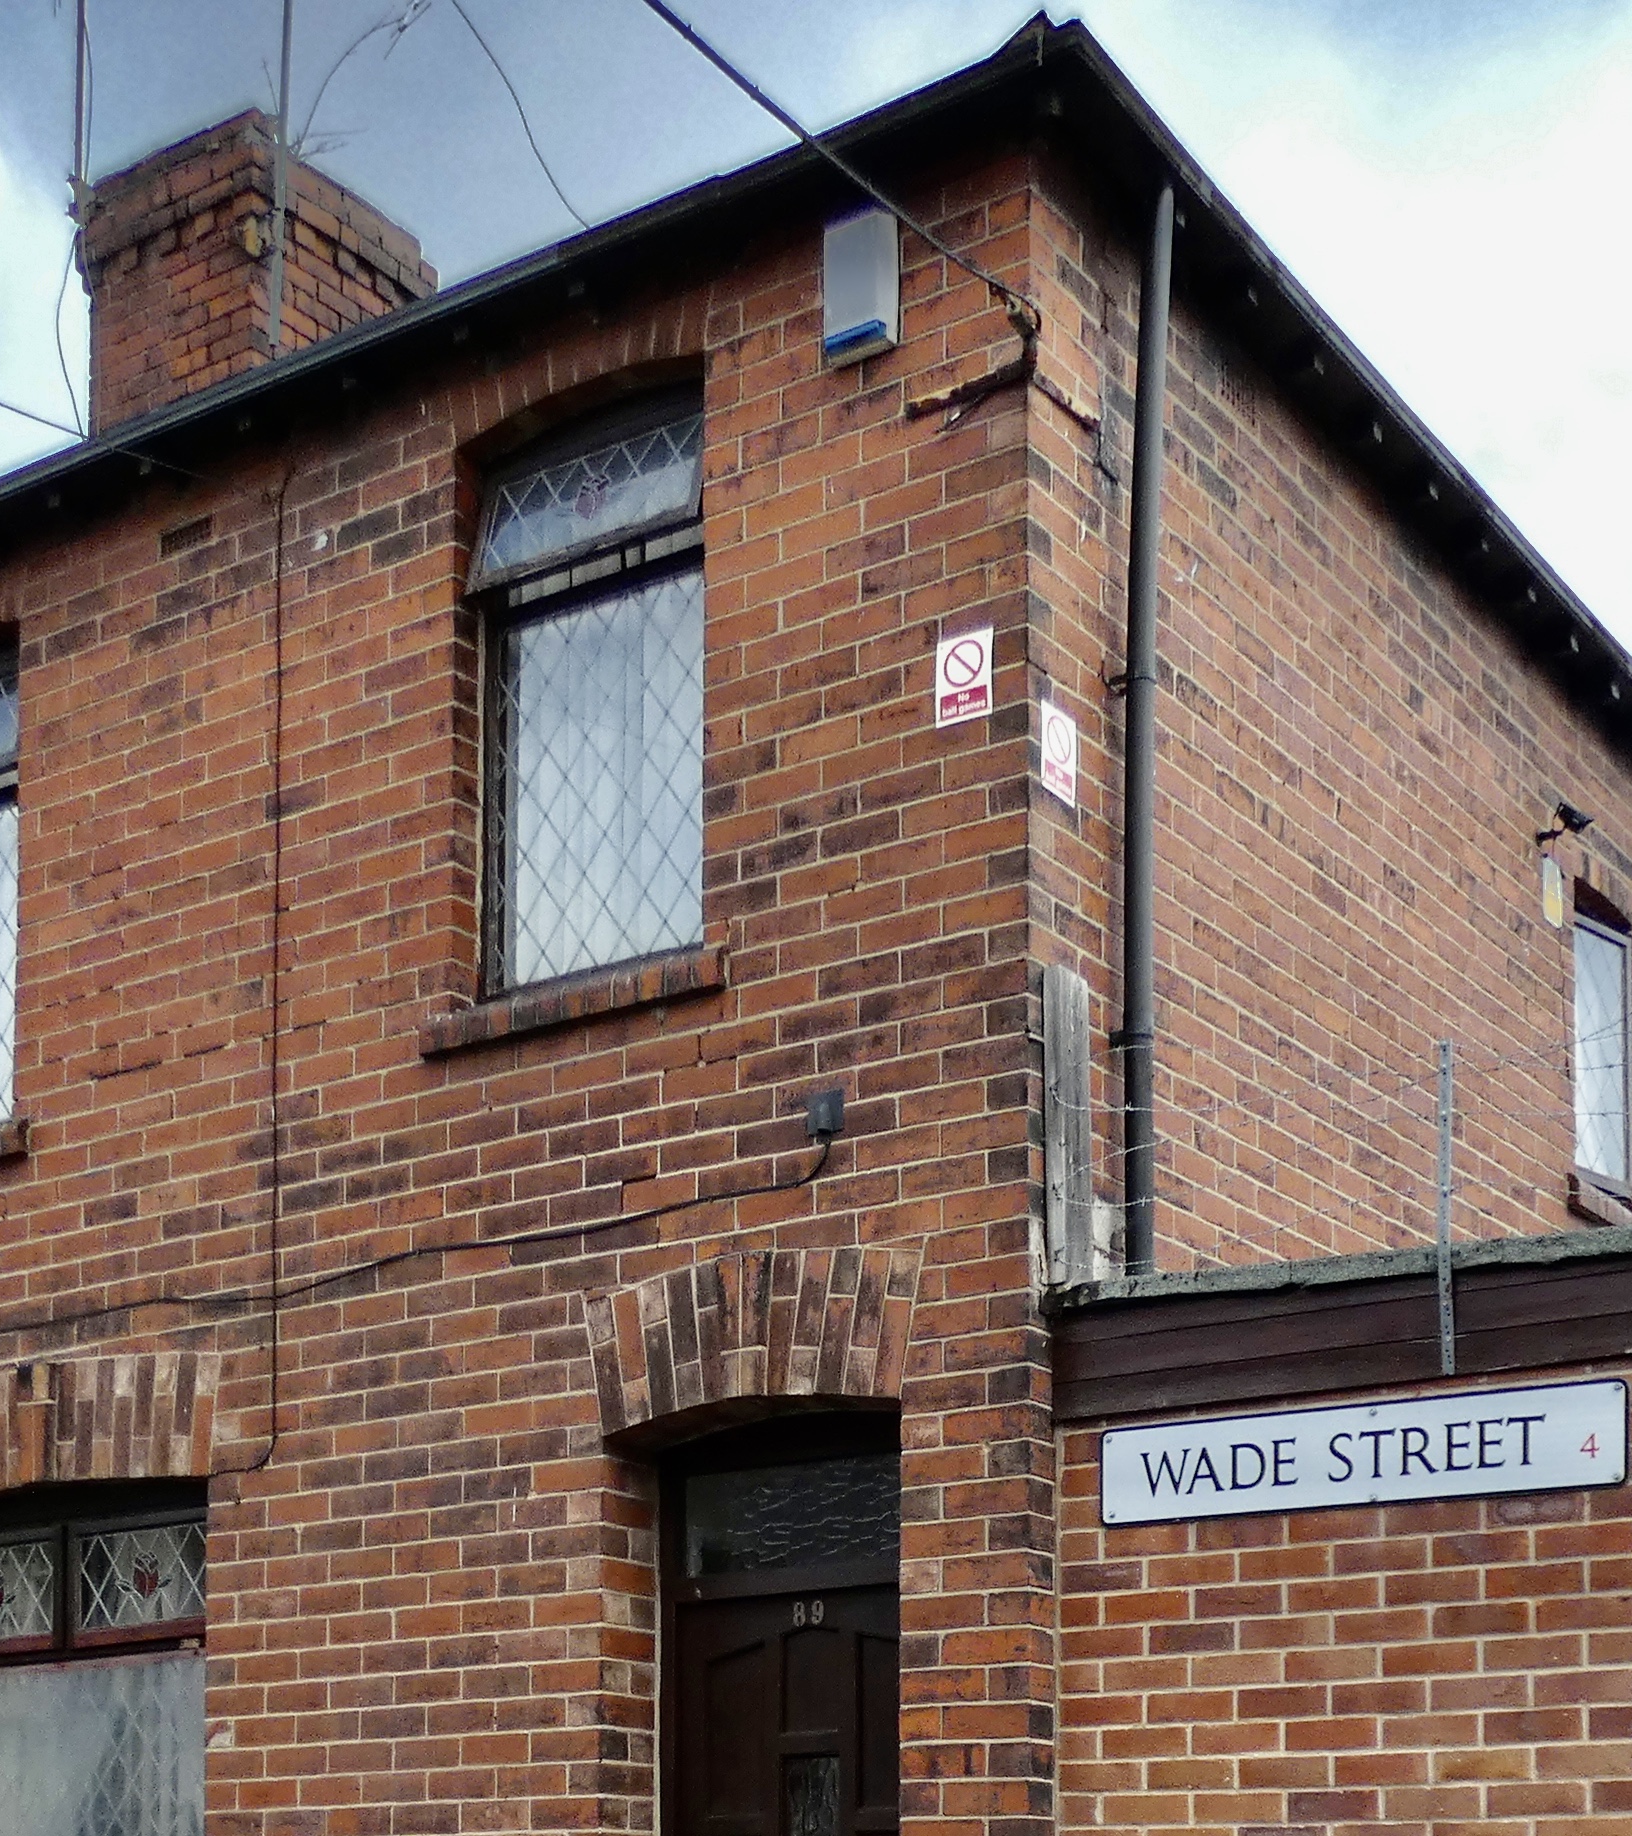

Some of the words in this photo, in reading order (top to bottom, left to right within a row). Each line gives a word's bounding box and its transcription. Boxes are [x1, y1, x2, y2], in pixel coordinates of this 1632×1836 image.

[958, 692, 970, 703] No
[958, 699, 986, 715] games
[1141, 1437, 1298, 1498] WADE
[1327, 1413, 1546, 1483] STREET
[1580, 1433, 1601, 1459] 4
[792, 1600, 824, 1627] 89
